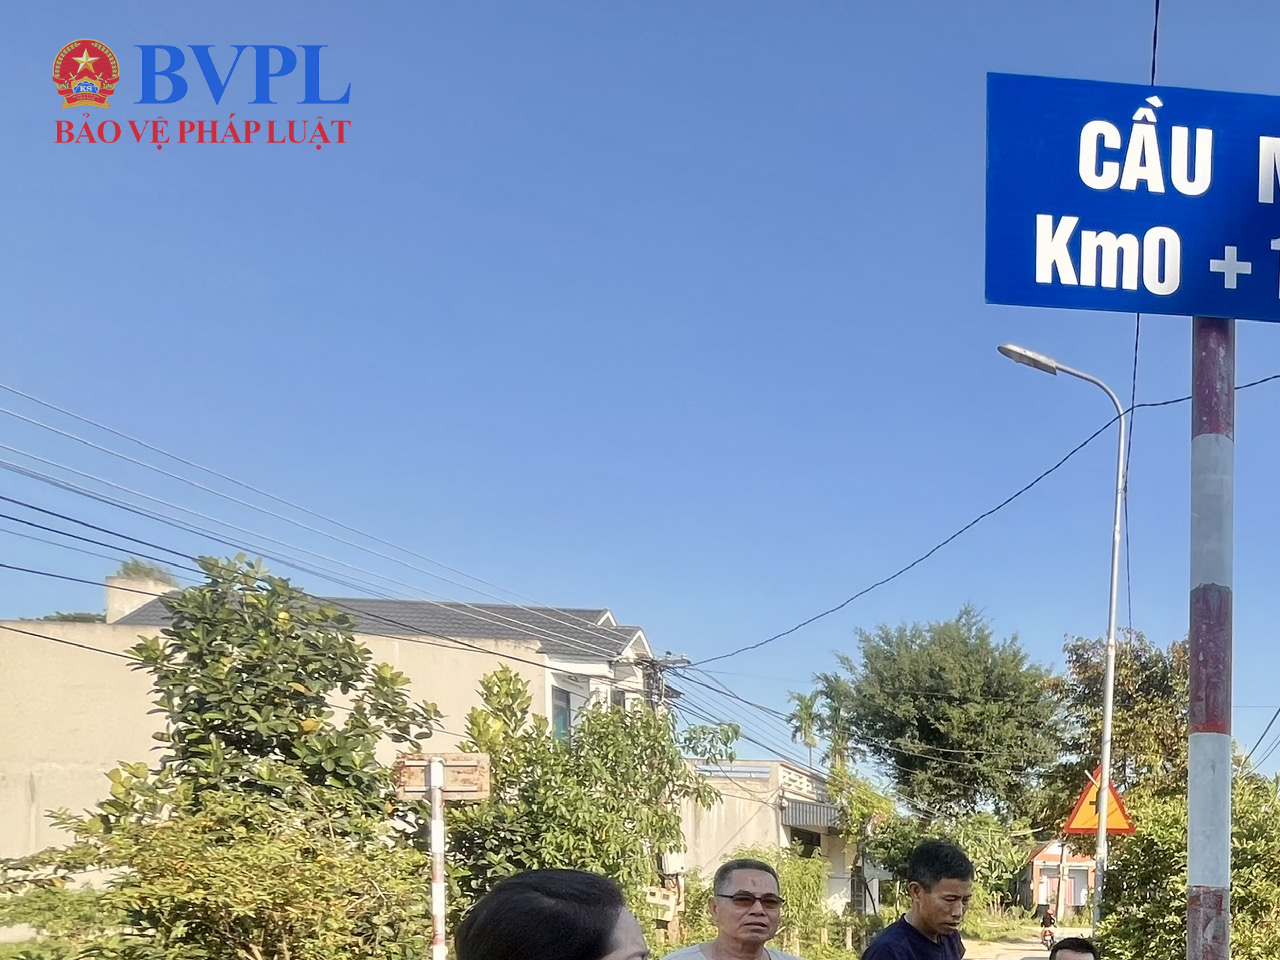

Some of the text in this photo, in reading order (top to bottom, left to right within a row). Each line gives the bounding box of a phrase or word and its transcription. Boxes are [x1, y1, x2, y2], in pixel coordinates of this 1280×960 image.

[1079, 95, 1213, 196] CẦU
[1035, 213, 1182, 296] Km0
[1209, 245, 1252, 289] +
